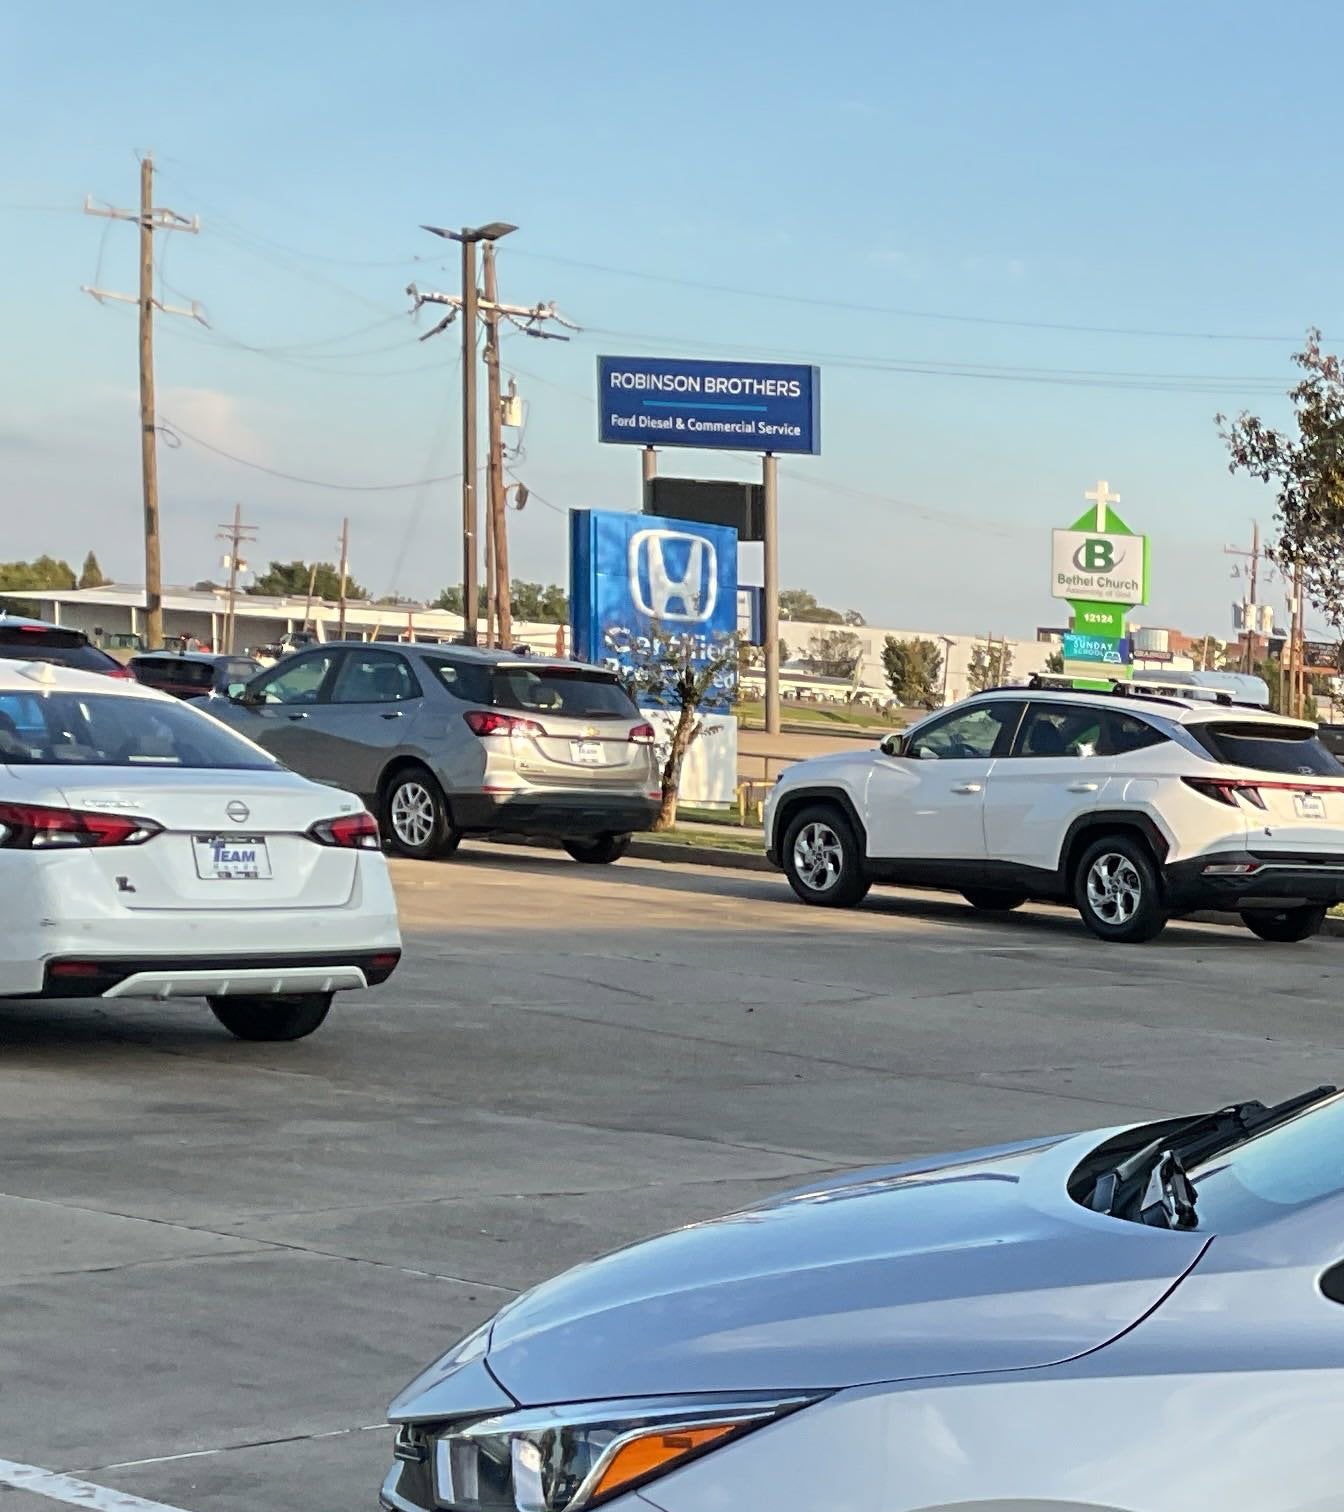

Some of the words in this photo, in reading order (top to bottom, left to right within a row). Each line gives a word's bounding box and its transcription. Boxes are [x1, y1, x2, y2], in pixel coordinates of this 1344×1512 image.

[610, 372, 700, 392] ROBINSON
[704, 376, 801, 397] BROTHERS
[611, 414, 636, 428] Ford
[639, 415, 673, 430] Diesel
[675, 417, 685, 430] &
[687, 418, 756, 434] Commercial
[758, 421, 801, 436] Service
[1057, 573, 1094, 587] Bethel
[1096, 576, 1139, 591] Church
[1083, 613, 1114, 624] 12124
[1073, 640, 1113, 652] SUNDAY
[209, 840, 256, 862] TEAM
